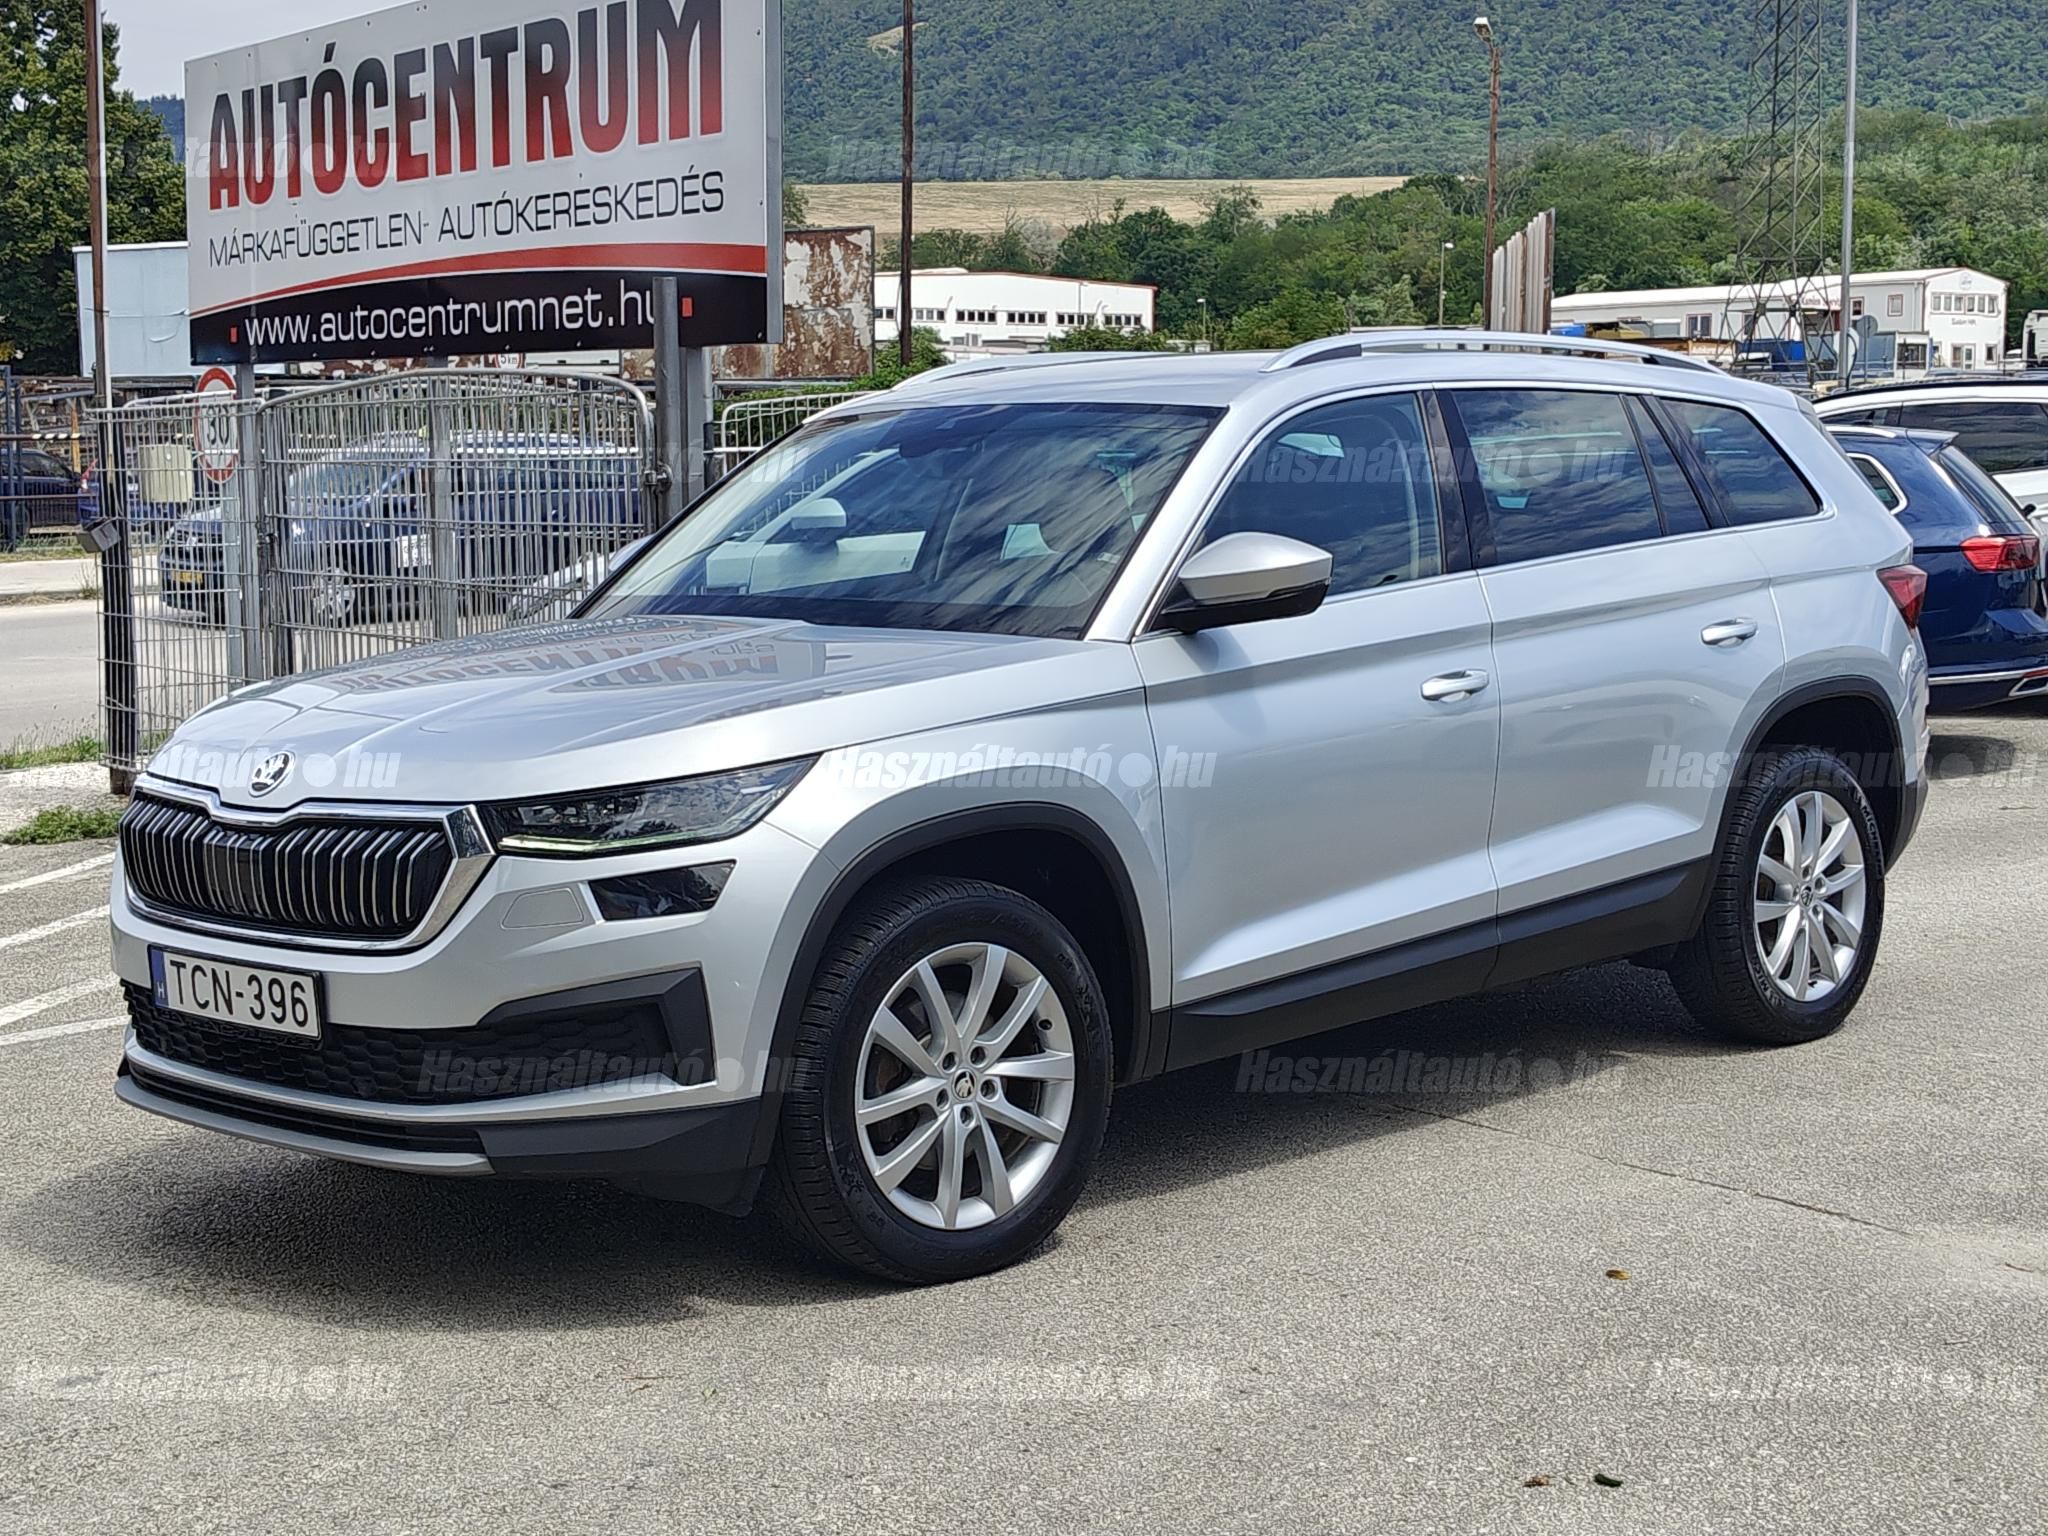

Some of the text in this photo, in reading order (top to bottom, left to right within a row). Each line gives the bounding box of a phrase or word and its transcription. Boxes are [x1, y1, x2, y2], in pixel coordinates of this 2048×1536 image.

[209, 0, 722, 211] AUTÓCENTRUM
[209, 164, 724, 268] MÁRKAFÜGGETLEN- AUTÓKERESKEDÉS
[157, 959, 309, 1028] H TCN-396
